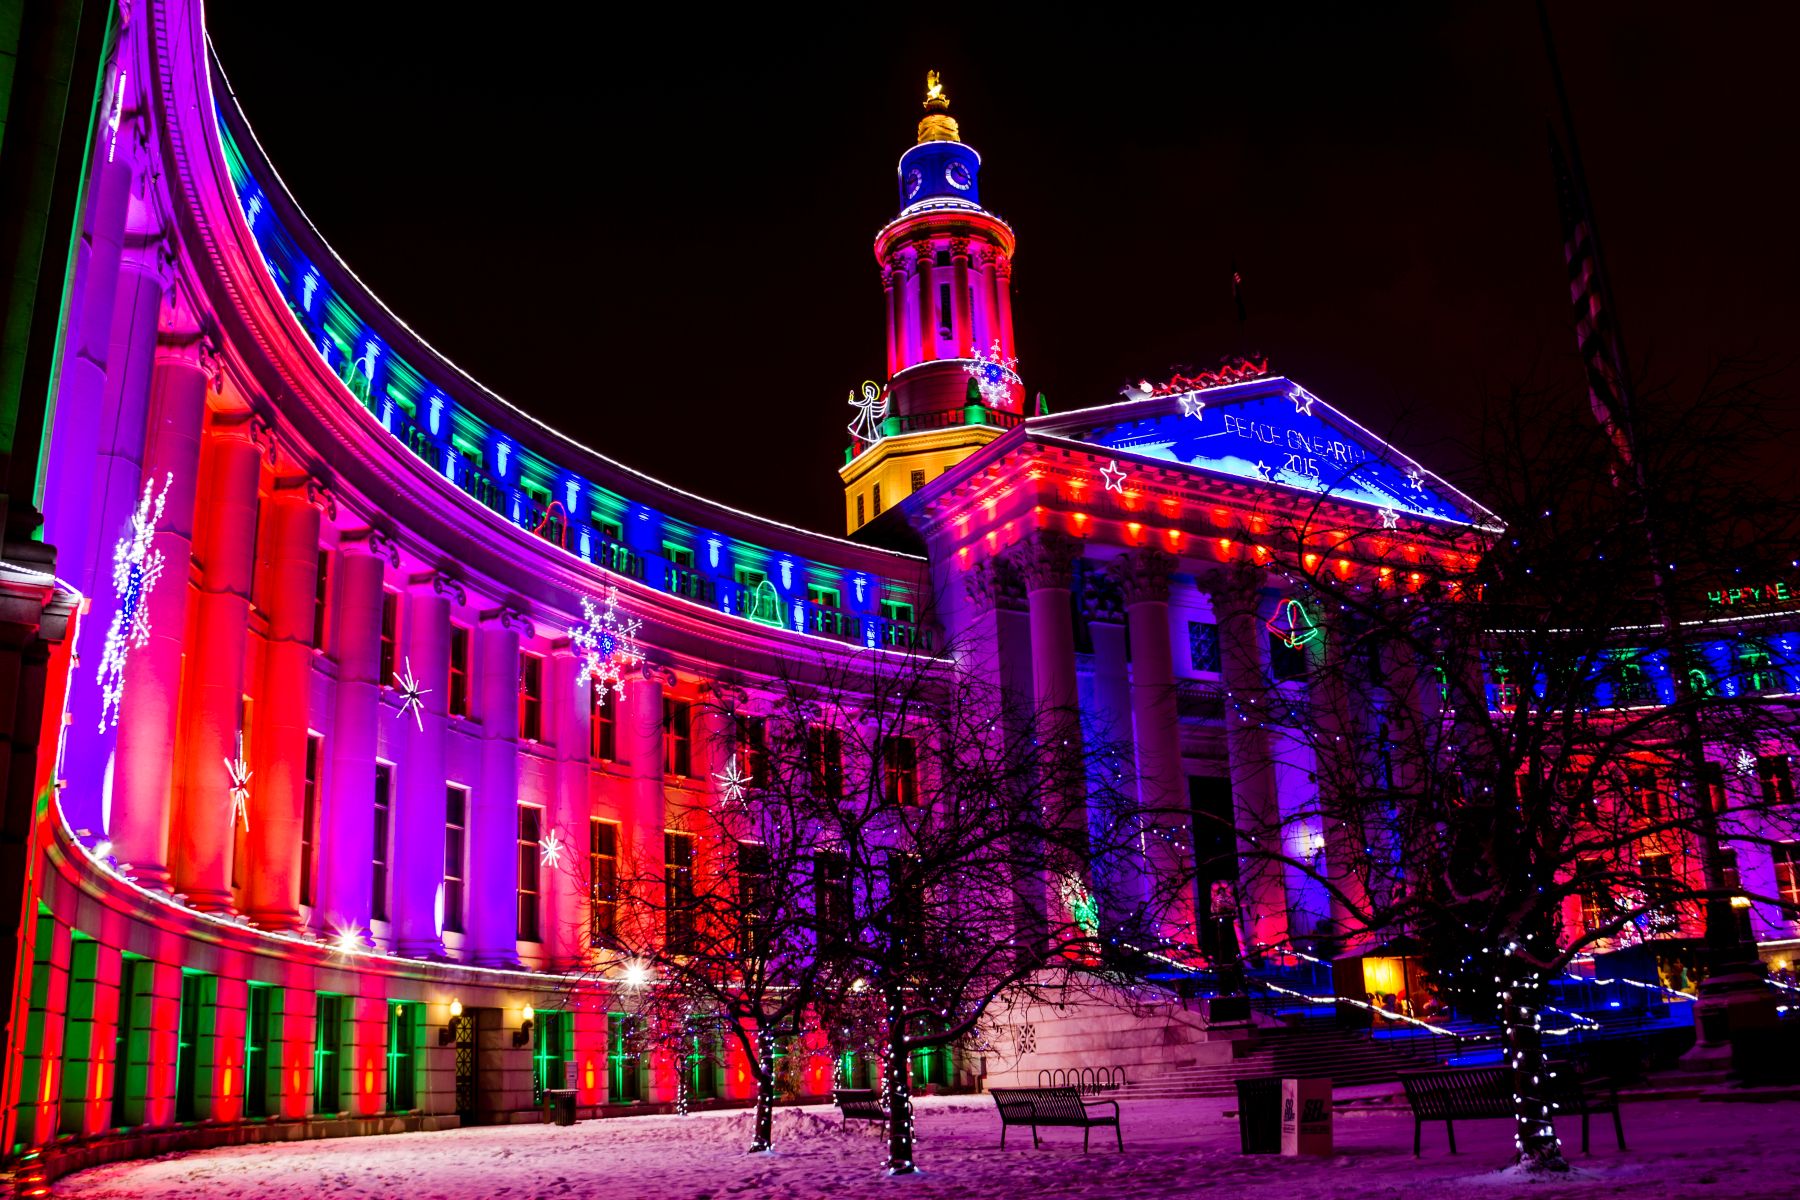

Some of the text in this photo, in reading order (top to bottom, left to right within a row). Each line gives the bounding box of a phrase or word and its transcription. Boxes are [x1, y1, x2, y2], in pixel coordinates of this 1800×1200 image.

[1224, 414, 1366, 465] PEACE ON EARTH
[1283, 452, 1320, 478] 2015
[1707, 587, 1760, 608] HAPPY
